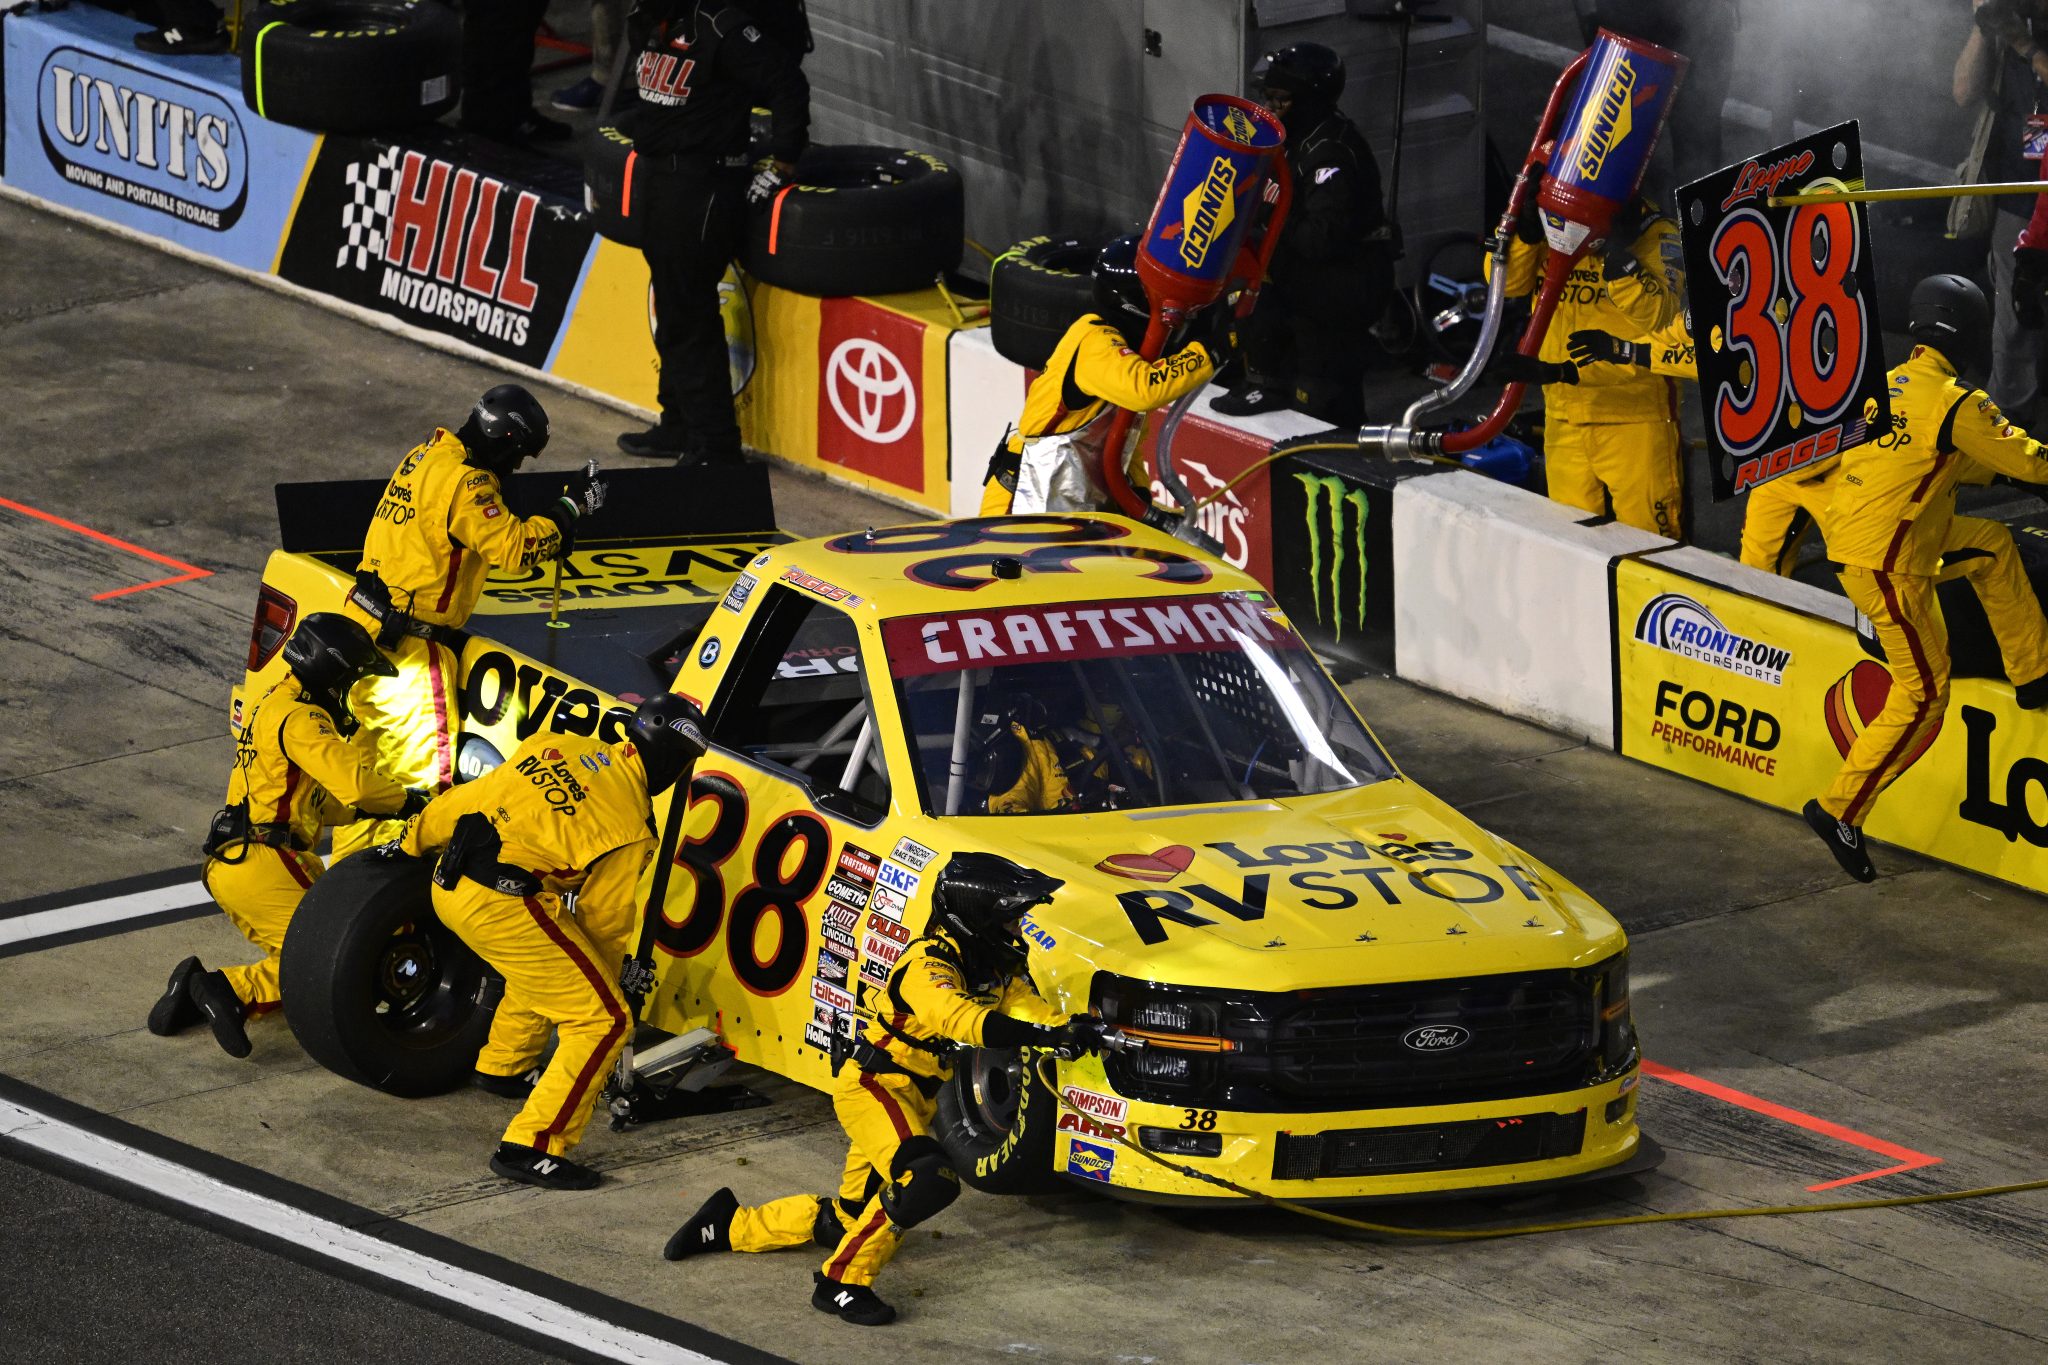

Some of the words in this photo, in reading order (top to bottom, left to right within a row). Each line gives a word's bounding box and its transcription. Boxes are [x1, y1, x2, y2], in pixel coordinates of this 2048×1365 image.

[639, 51, 696, 97] HILL
[52, 65, 230, 192] UNITS
[1577, 60, 1634, 179] SUNOCO
[65, 162, 103, 188] MOVING
[105, 175, 125, 198] AND
[126, 183, 175, 213] PORTABLE
[176, 200, 220, 228] STORAGE
[1721, 150, 1815, 212] Layne
[384, 150, 541, 313] HILL
[1181, 157, 1236, 268] SUNOCO
[380, 267, 531, 346] MOTORSPORTS
[1709, 176, 1867, 457] 38
[1734, 424, 1844, 495] RIGGS
[823, 514, 1214, 593] 38
[725, 595, 744, 610] TOUGH
[736, 572, 755, 589] BUILT
[780, 569, 852, 602] RIGGS
[920, 602, 1277, 665] CRAFTSMAN
[1671, 640, 1782, 685] MOTORSPORTS
[1654, 679, 1781, 752] FORD
[1651, 720, 1778, 777] PERFORMANCE
[840, 854, 877, 878] CRAFTSMAN
[893, 849, 908, 862] RACE
[908, 855, 924, 868] TRUCK
[908, 842, 931, 860] NASCAR
[644, 769, 833, 998] 38
[827, 880, 868, 907] COMETIC
[878, 862, 919, 892] SKF
[828, 904, 858, 927] KLOTZ
[1114, 873, 1271, 946] RV
[1288, 864, 1555, 911] STOP
[822, 924, 855, 948] LINCOLN
[827, 940, 856, 960] WELDERS
[867, 912, 911, 945] CALICO
[814, 982, 852, 1013] tilton
[1414, 1024, 1459, 1049] Ford
[975, 1046, 1032, 1178] OODYEAR
[1066, 1090, 1122, 1117] SIMPSON
[1178, 1108, 1218, 1131] 38
[1070, 1152, 1113, 1171] SUNOCO
